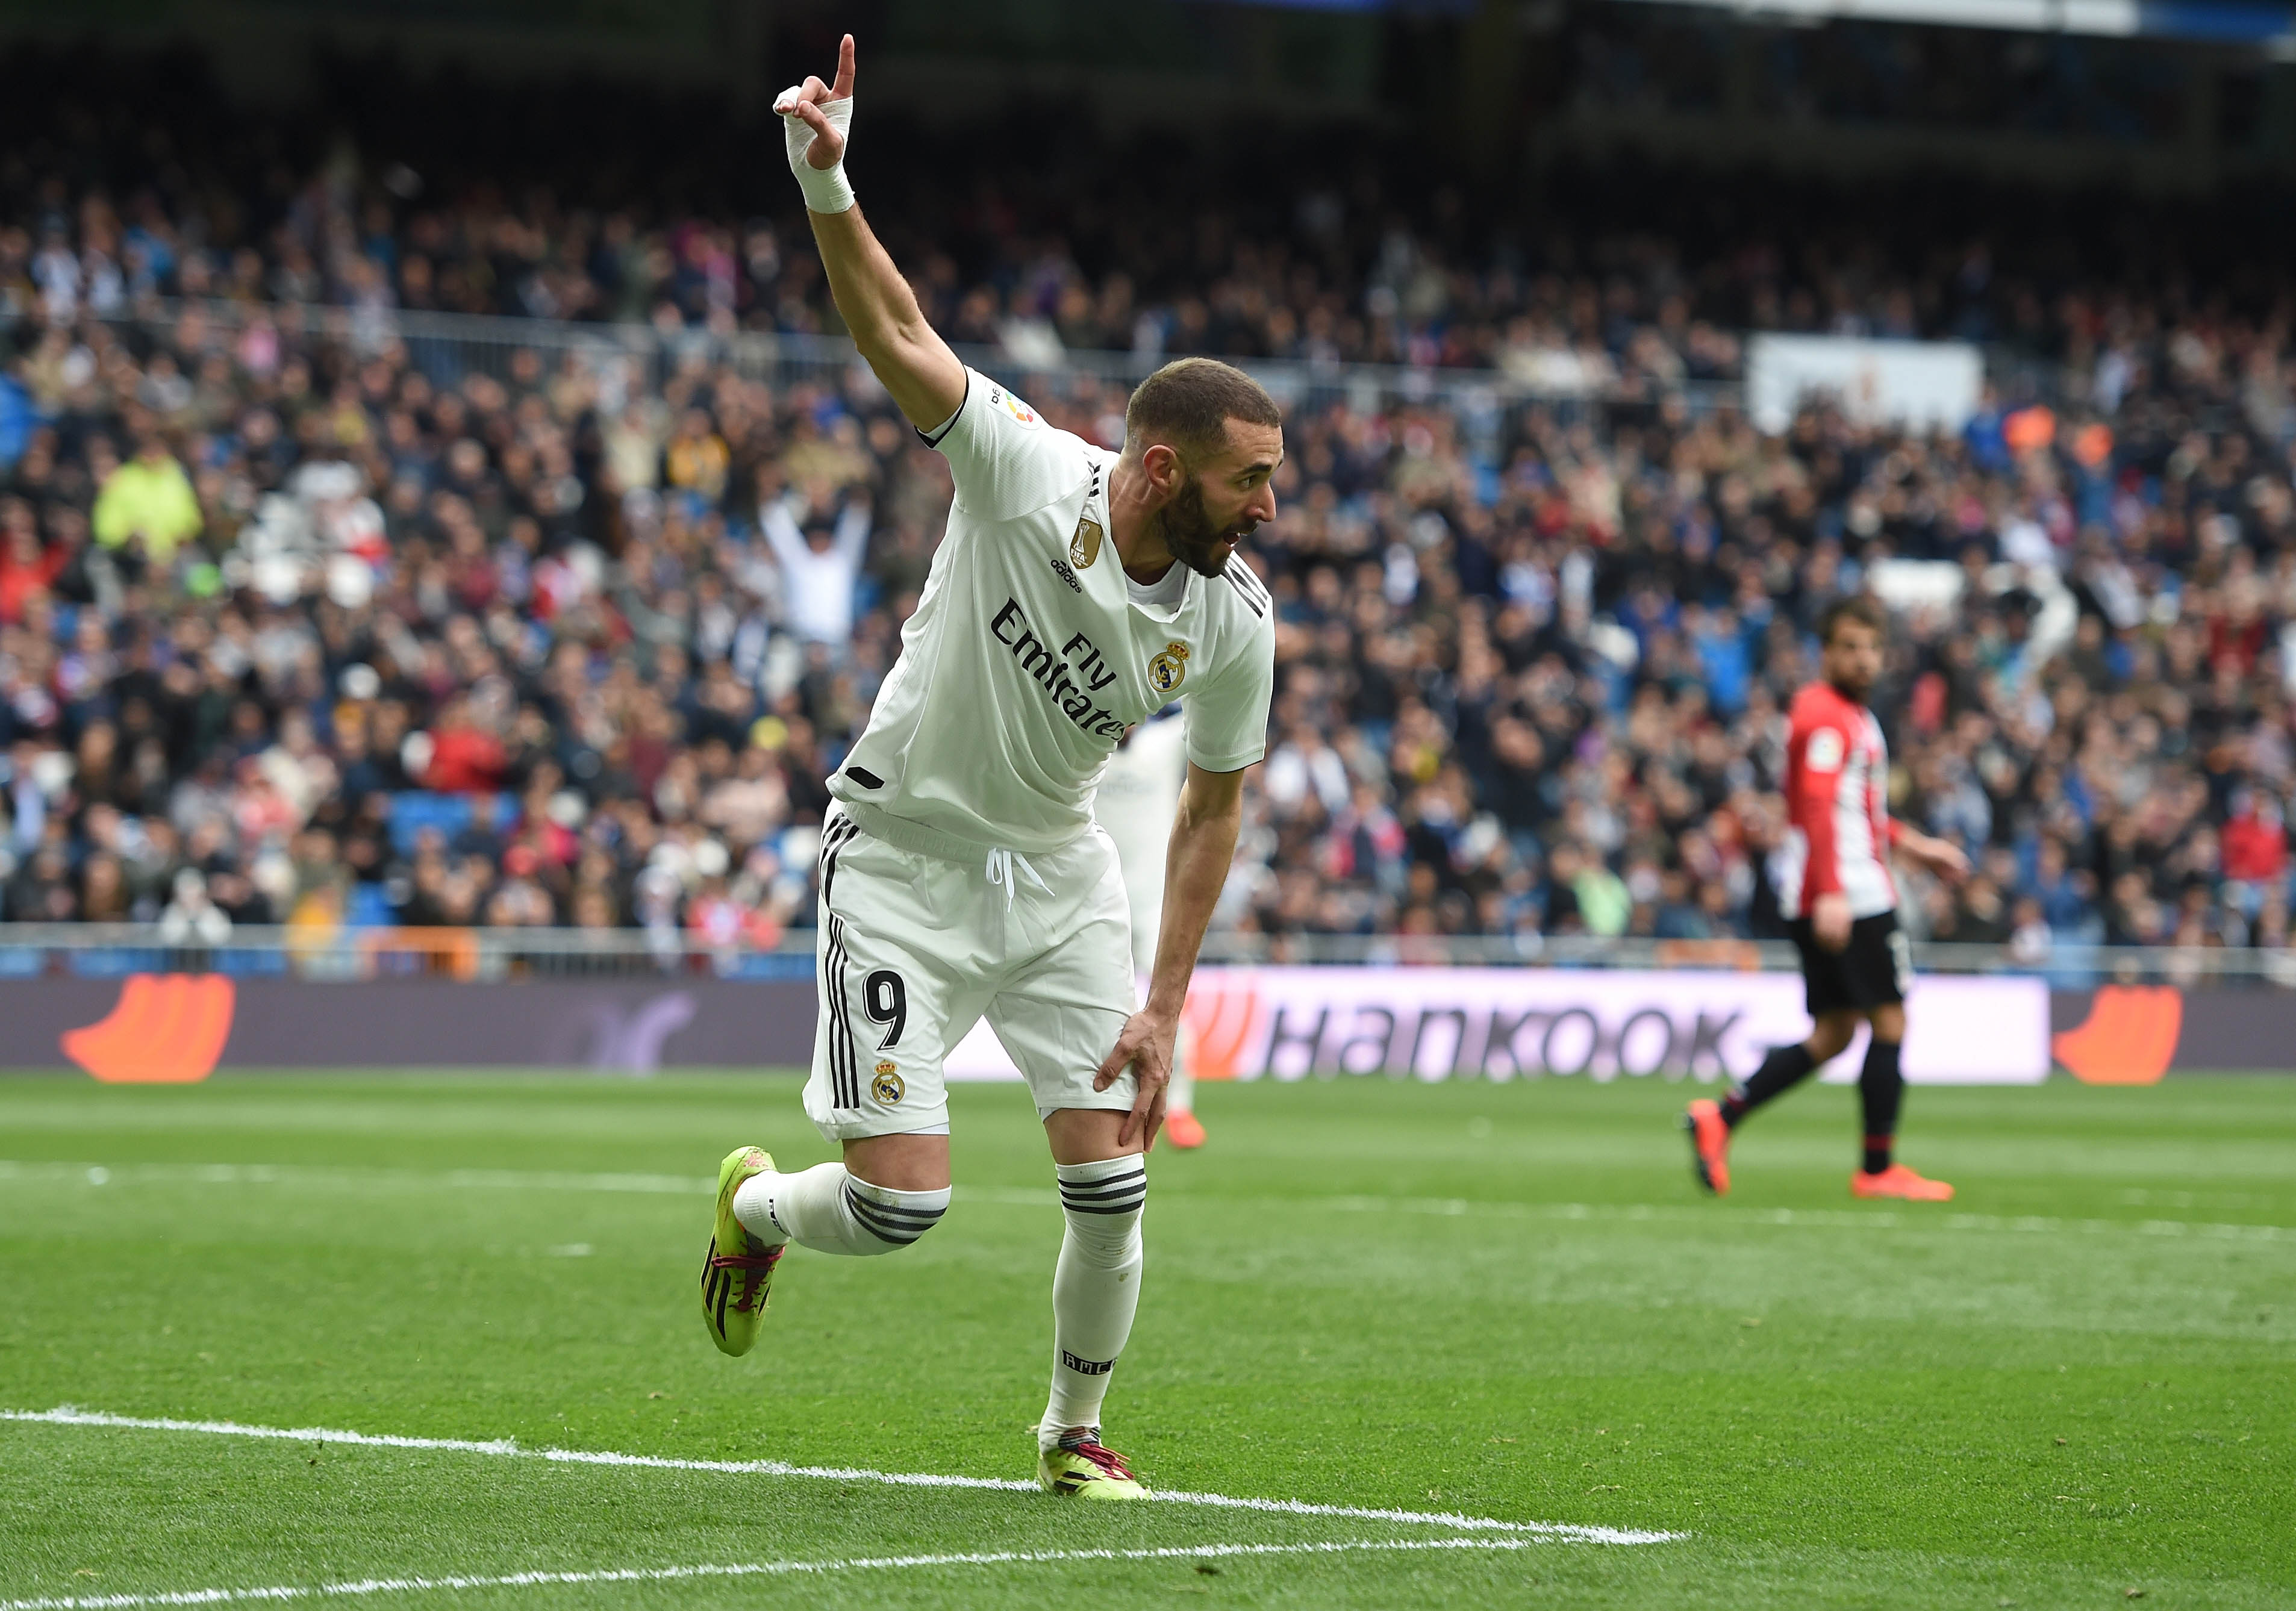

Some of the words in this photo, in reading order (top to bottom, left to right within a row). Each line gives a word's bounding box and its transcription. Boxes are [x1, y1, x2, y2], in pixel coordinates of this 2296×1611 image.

[1050, 559, 1082, 593] adidas
[1071, 548, 1085, 562] FIFA
[1061, 631, 1117, 691] Fly
[862, 970, 907, 1052] 9
